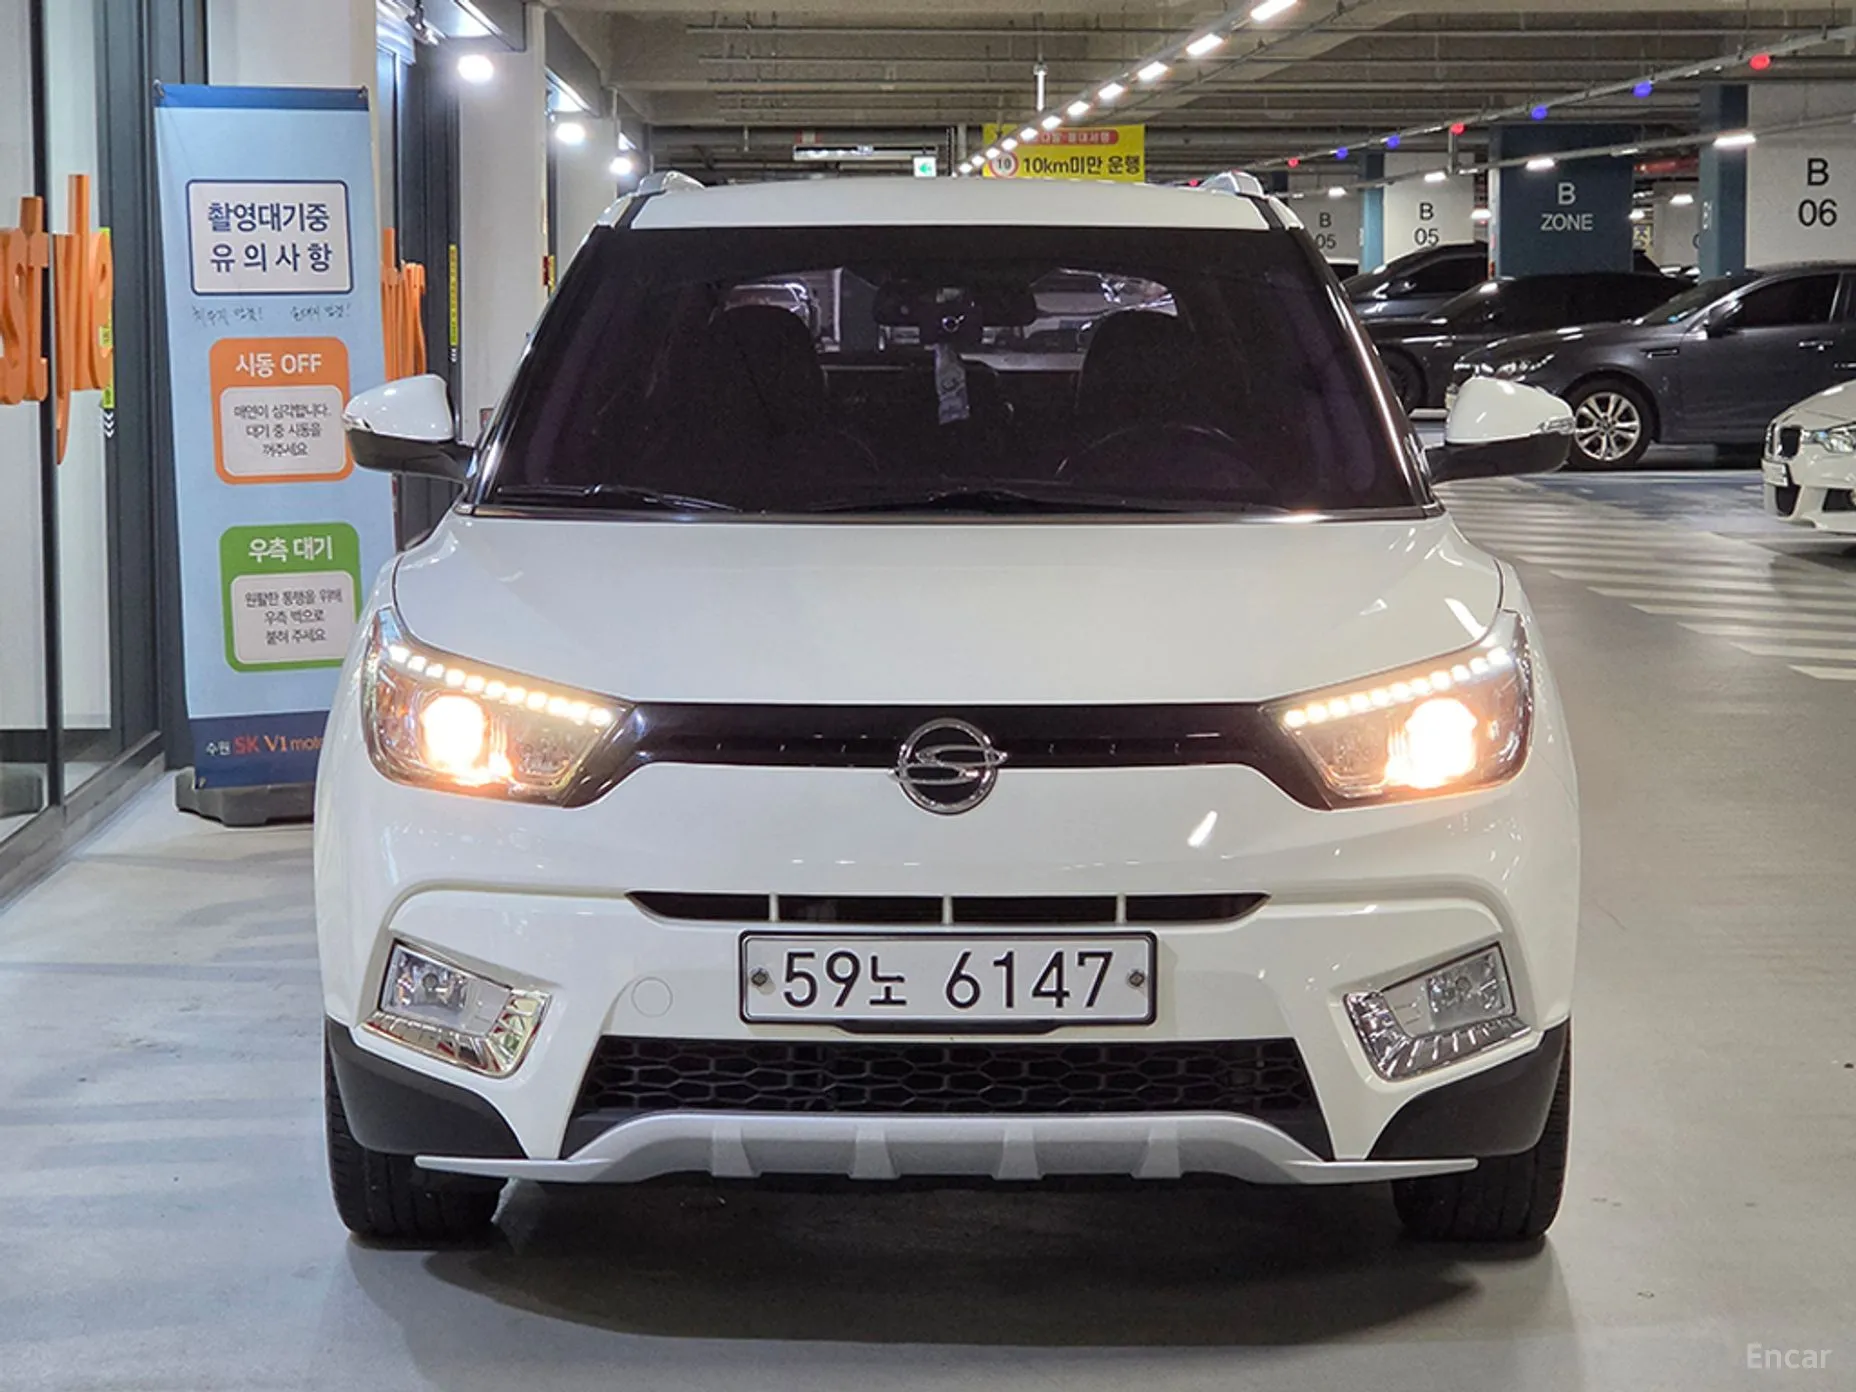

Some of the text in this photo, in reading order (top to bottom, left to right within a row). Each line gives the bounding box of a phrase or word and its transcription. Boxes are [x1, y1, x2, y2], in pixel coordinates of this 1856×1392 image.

[998, 158, 1012, 170] 10
[1024, 155, 1141, 175] 10km미만 운행
[1807, 157, 1829, 186] B
[1558, 182, 1576, 205] B
[208, 202, 330, 232] 촬영대기중
[1319, 212, 1332, 228] B
[1420, 203, 1434, 220] B
[1798, 198, 1838, 227] 06
[1540, 213, 1594, 231] ZONE
[1315, 233, 1337, 249] 05
[1414, 227, 1439, 246] 05
[235, 353, 322, 378] 시동 OFF
[273, 424, 285, 438] 중
[288, 422, 322, 438] 시동을
[262, 442, 308, 457] 꺼주세요
[248, 536, 333, 562] 우측 대기
[245, 588, 343, 608] 원활한 통행을 위해
[264, 610, 288, 625] 우측
[292, 628, 326, 643] 주세요
[206, 740, 231, 756] 수원
[234, 735, 260, 755] SK
[783, 951, 1114, 1009] 59노 6147
